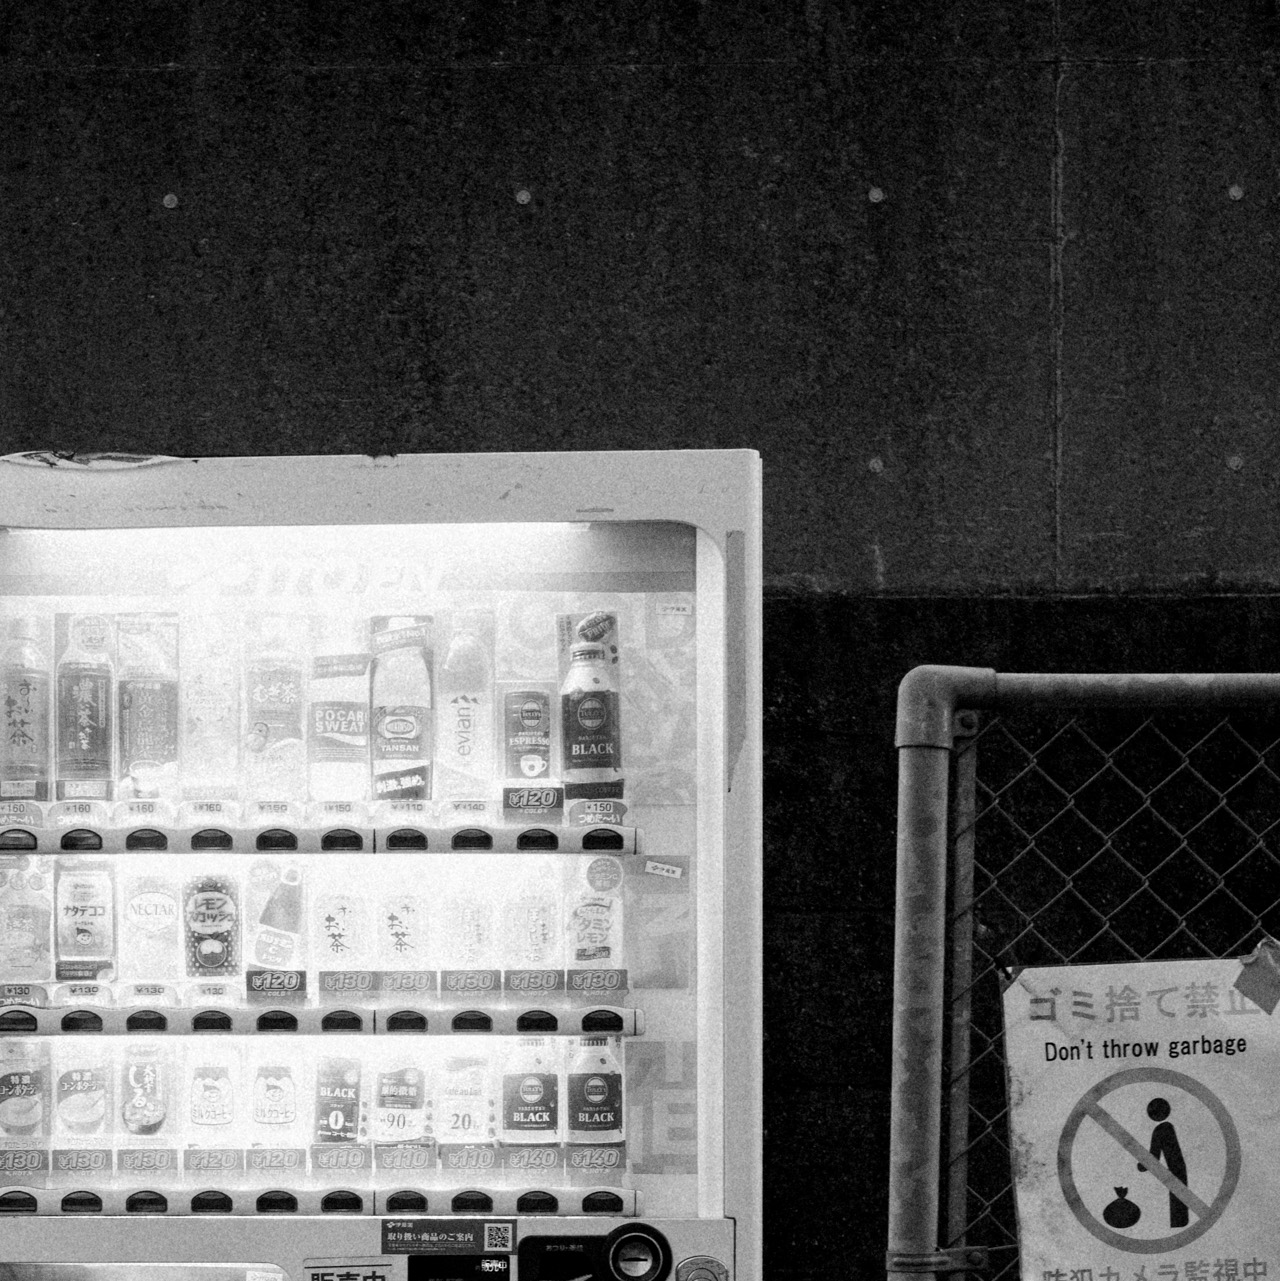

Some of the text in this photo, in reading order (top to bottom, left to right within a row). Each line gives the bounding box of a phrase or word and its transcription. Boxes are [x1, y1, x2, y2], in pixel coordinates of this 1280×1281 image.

[252, 682, 297, 703] むぎ茶
[315, 721, 365, 732] SWEAT
[456, 705, 472, 757] evian
[571, 743, 614, 755] BLACK
[508, 788, 557, 808] ¥120
[0, 803, 25, 813] ¥160
[66, 803, 91, 813] ¥160
[128, 803, 154, 813] ¥160
[586, 803, 612, 812] ¥150
[63, 905, 106, 917] ナタデココ
[130, 903, 175, 916] NECTAR
[194, 897, 227, 911] レモン
[188, 911, 234, 923] スカッシュ
[576, 932, 608, 944] レモン
[252, 972, 300, 990] ¥120
[324, 972, 373, 990] ¥130
[382, 972, 431, 990] ¥130
[446, 972, 495, 990] ¥130
[510, 972, 558, 990] ¥130
[571, 971, 620, 990] ¥130
[6, 986, 30, 996] ¥130
[69, 985, 99, 995] ¥130
[135, 986, 165, 996] ¥130
[1029, 981, 1260, 1023] ゴミ捨て禁止
[1044, 1035, 1247, 1061] Don't throw garbage
[320, 1086, 356, 1098] BLACK
[386, 1113, 406, 1130] 90
[450, 1113, 472, 1130] 20
[513, 1111, 551, 1122] BLACK
[578, 1111, 615, 1122] BLACK
[58, 1150, 106, 1170] ¥130
[123, 1150, 171, 1170] ¥130
[189, 1150, 237, 1169] ¥120
[252, 1150, 300, 1169] ¥120
[318, 1149, 365, 1168] ¥110
[382, 1149, 429, 1168] ¥110
[447, 1149, 495, 1168] ¥110
[509, 1149, 558, 1168] ¥140
[571, 1149, 620, 1168] ¥140
[387, 1232, 474, 1242] 取り扱い商品のご案内
